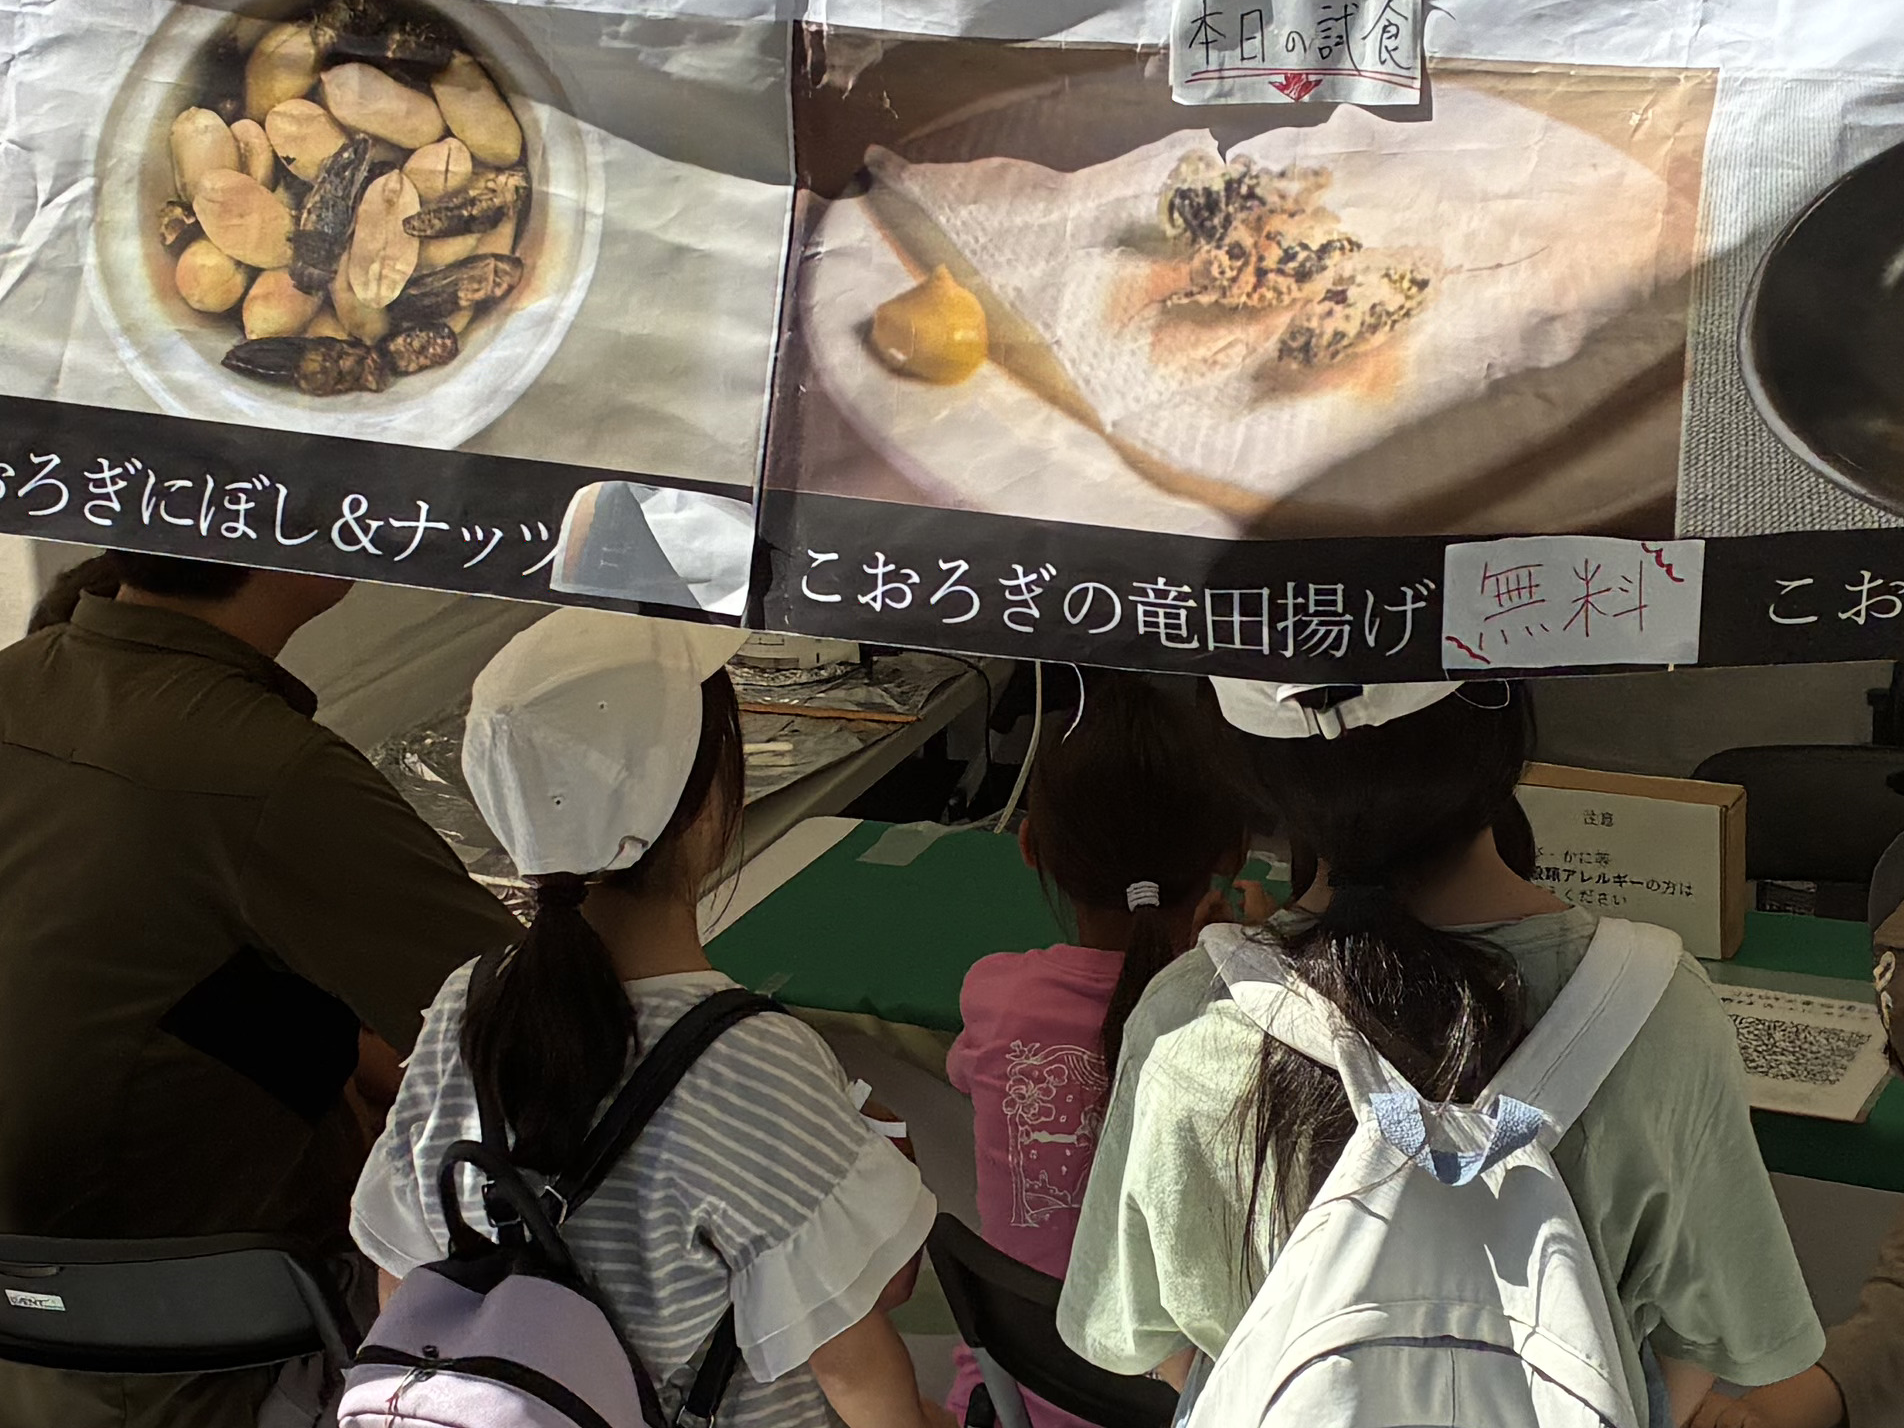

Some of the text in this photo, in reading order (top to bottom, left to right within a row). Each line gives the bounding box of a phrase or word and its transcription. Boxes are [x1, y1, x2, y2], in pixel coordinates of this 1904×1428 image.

[799, 547, 1439, 659] こおろぎの竜田揚げ
[1477, 557, 1649, 650] 無料
